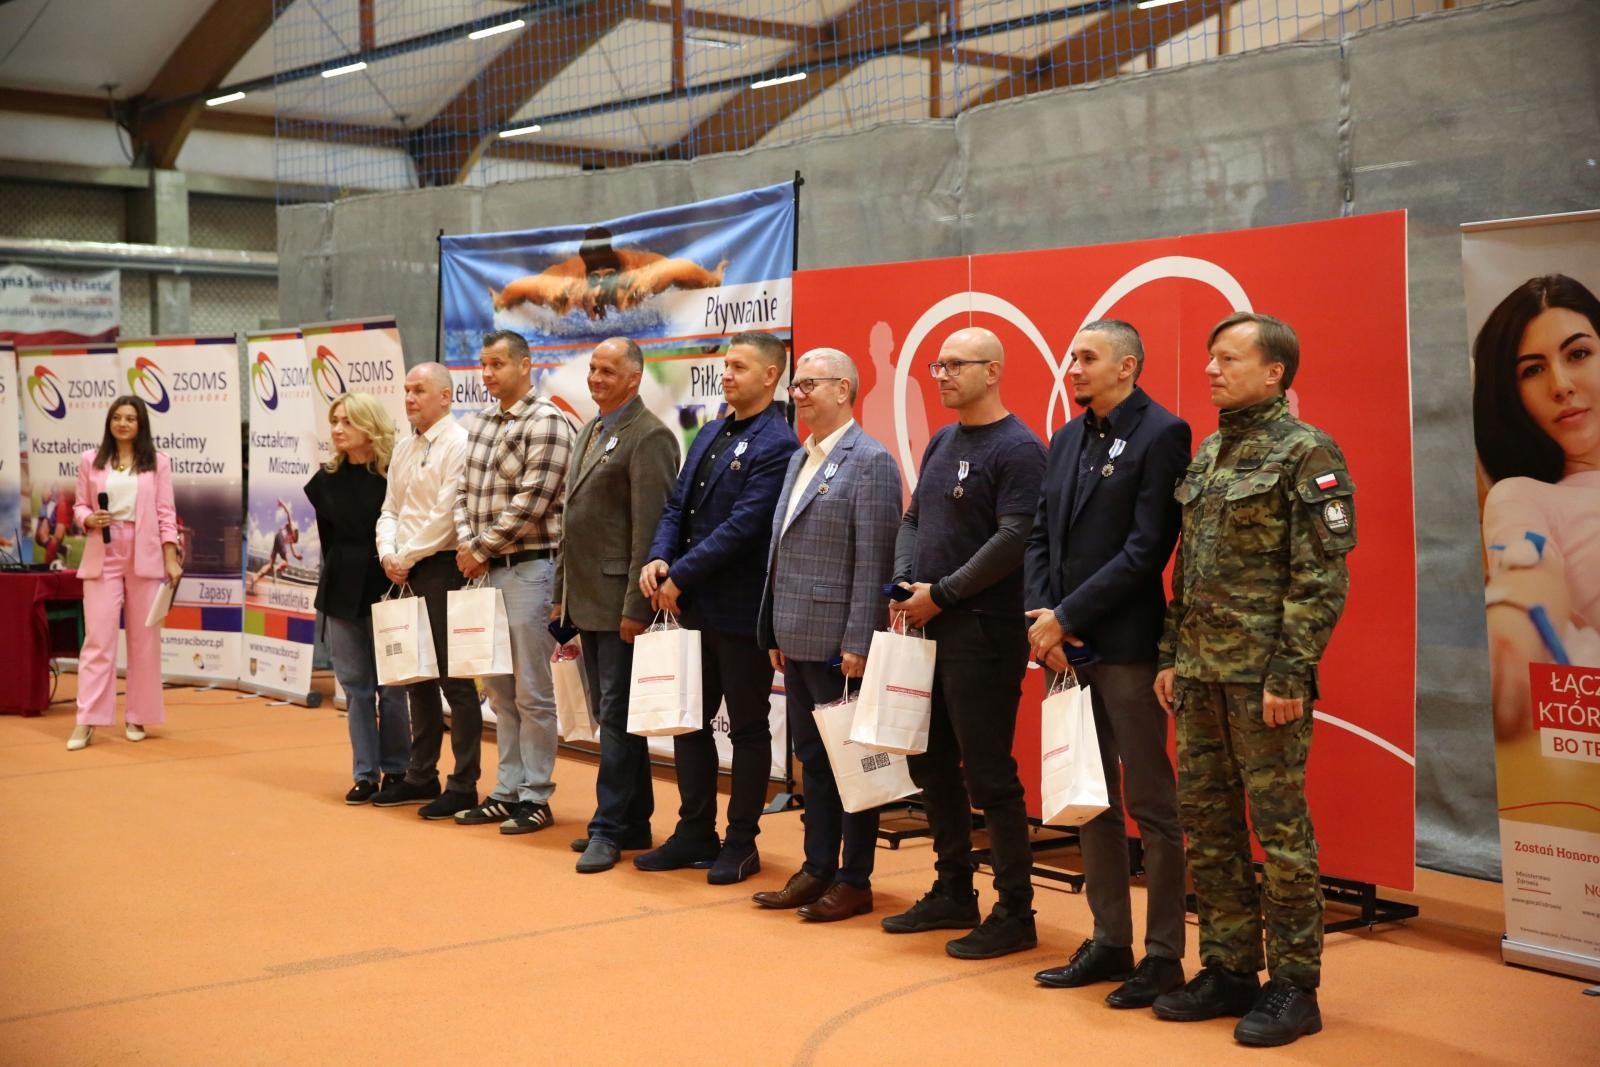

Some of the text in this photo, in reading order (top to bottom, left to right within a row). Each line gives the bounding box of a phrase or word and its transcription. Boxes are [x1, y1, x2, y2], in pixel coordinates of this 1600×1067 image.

[705, 290, 777, 335] Pływanie
[172, 372, 227, 391] ZSOMS
[281, 367, 311, 387] ZSOM
[348, 360, 394, 383] ZSOMS
[68, 380, 116, 399] ZSOMS
[153, 432, 207, 454] tałcimy
[251, 431, 299, 453] Kształcimy
[269, 457, 310, 475] Mistrzów
[200, 582, 232, 604] Zapasy
[1539, 700, 1600, 727] KTÓR
[1553, 736, 1579, 754] BO
[1514, 840, 1600, 865] Zostań Honoro
